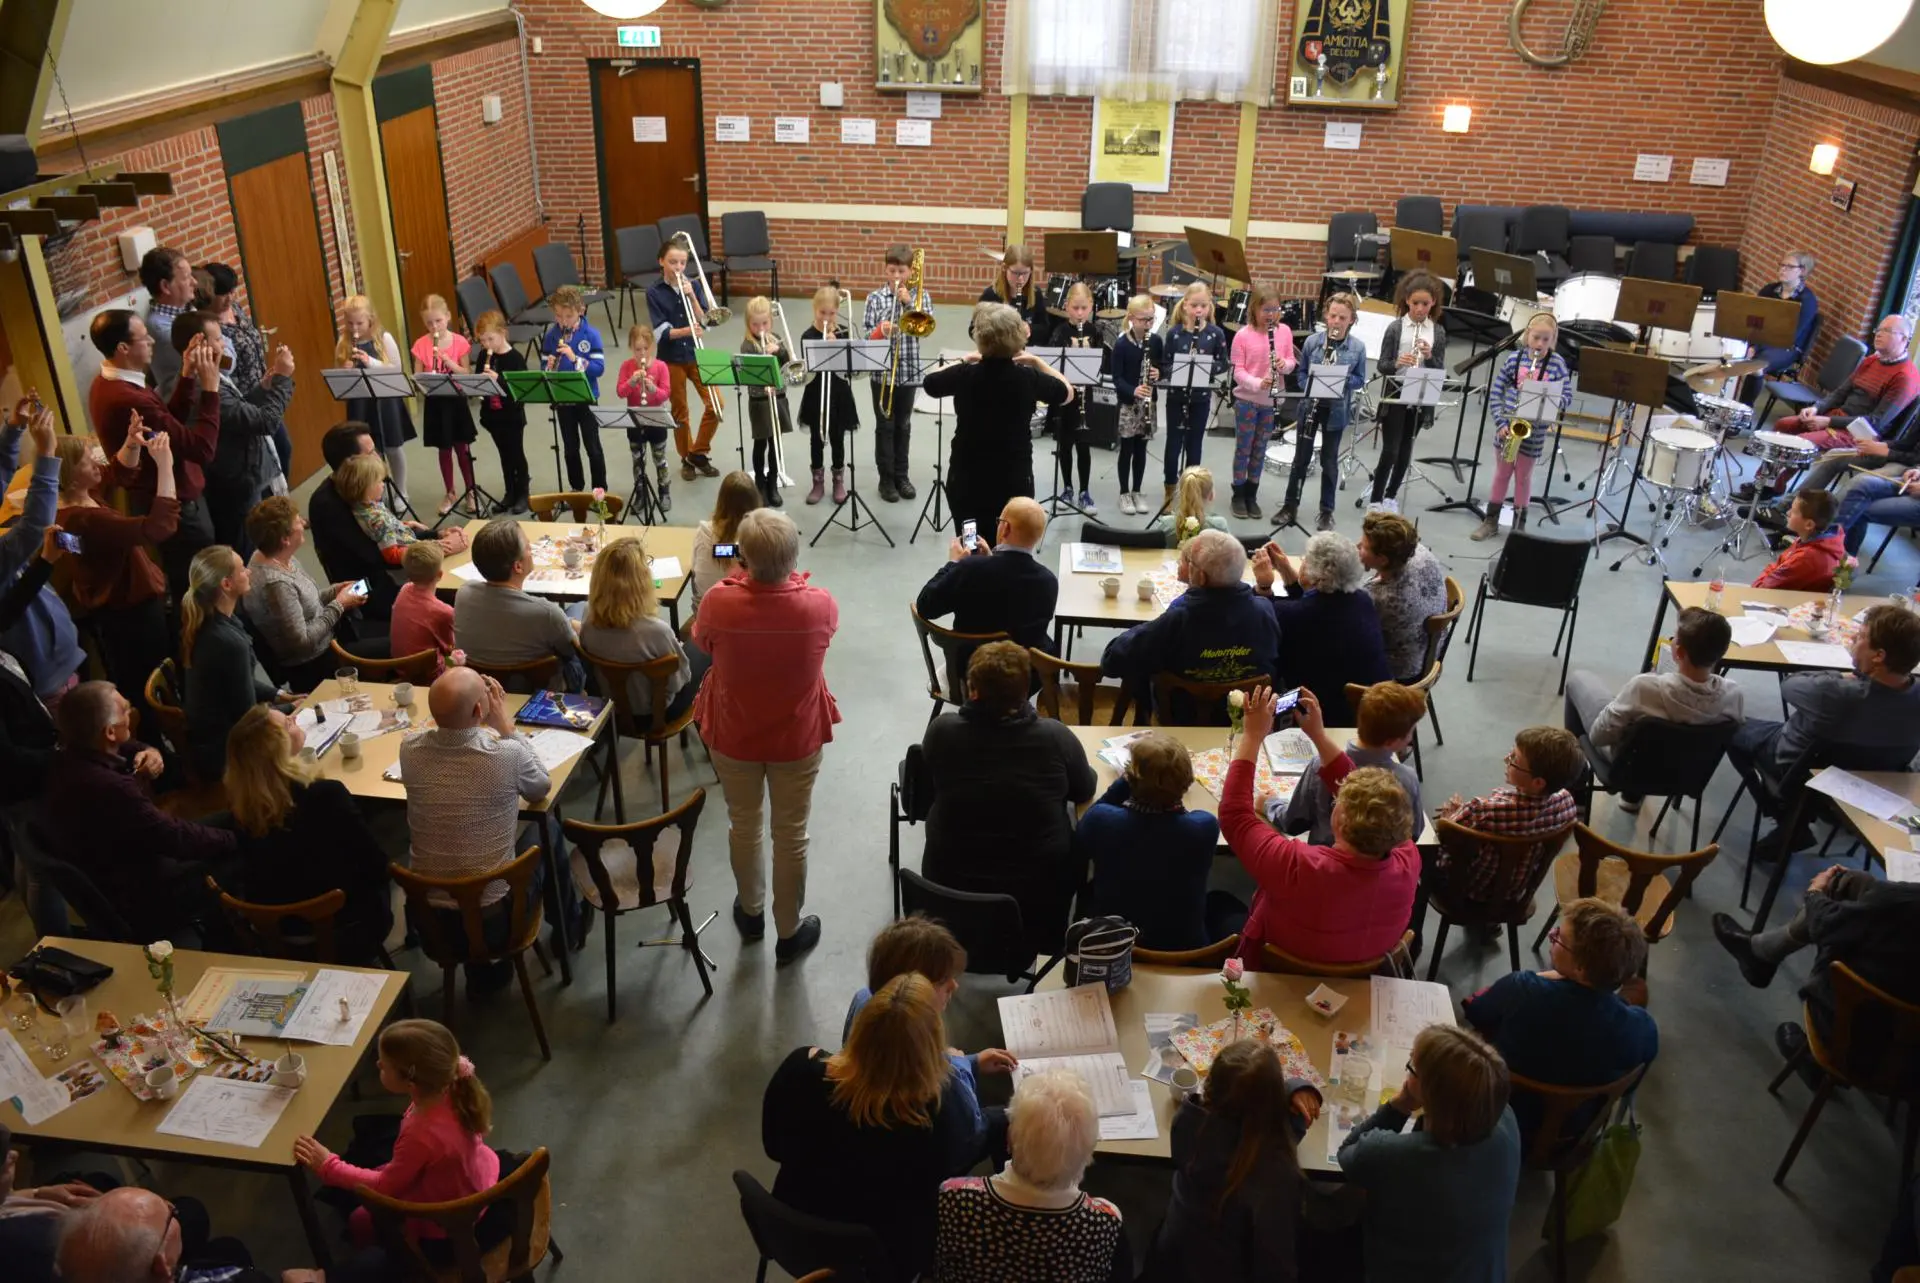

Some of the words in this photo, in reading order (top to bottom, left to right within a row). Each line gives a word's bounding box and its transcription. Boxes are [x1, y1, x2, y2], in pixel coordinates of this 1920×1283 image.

[1323, 35, 1368, 48] AMICITIA
[1329, 48, 1360, 57] DELDEN
[1200, 646, 1252, 659] Motorrijder
